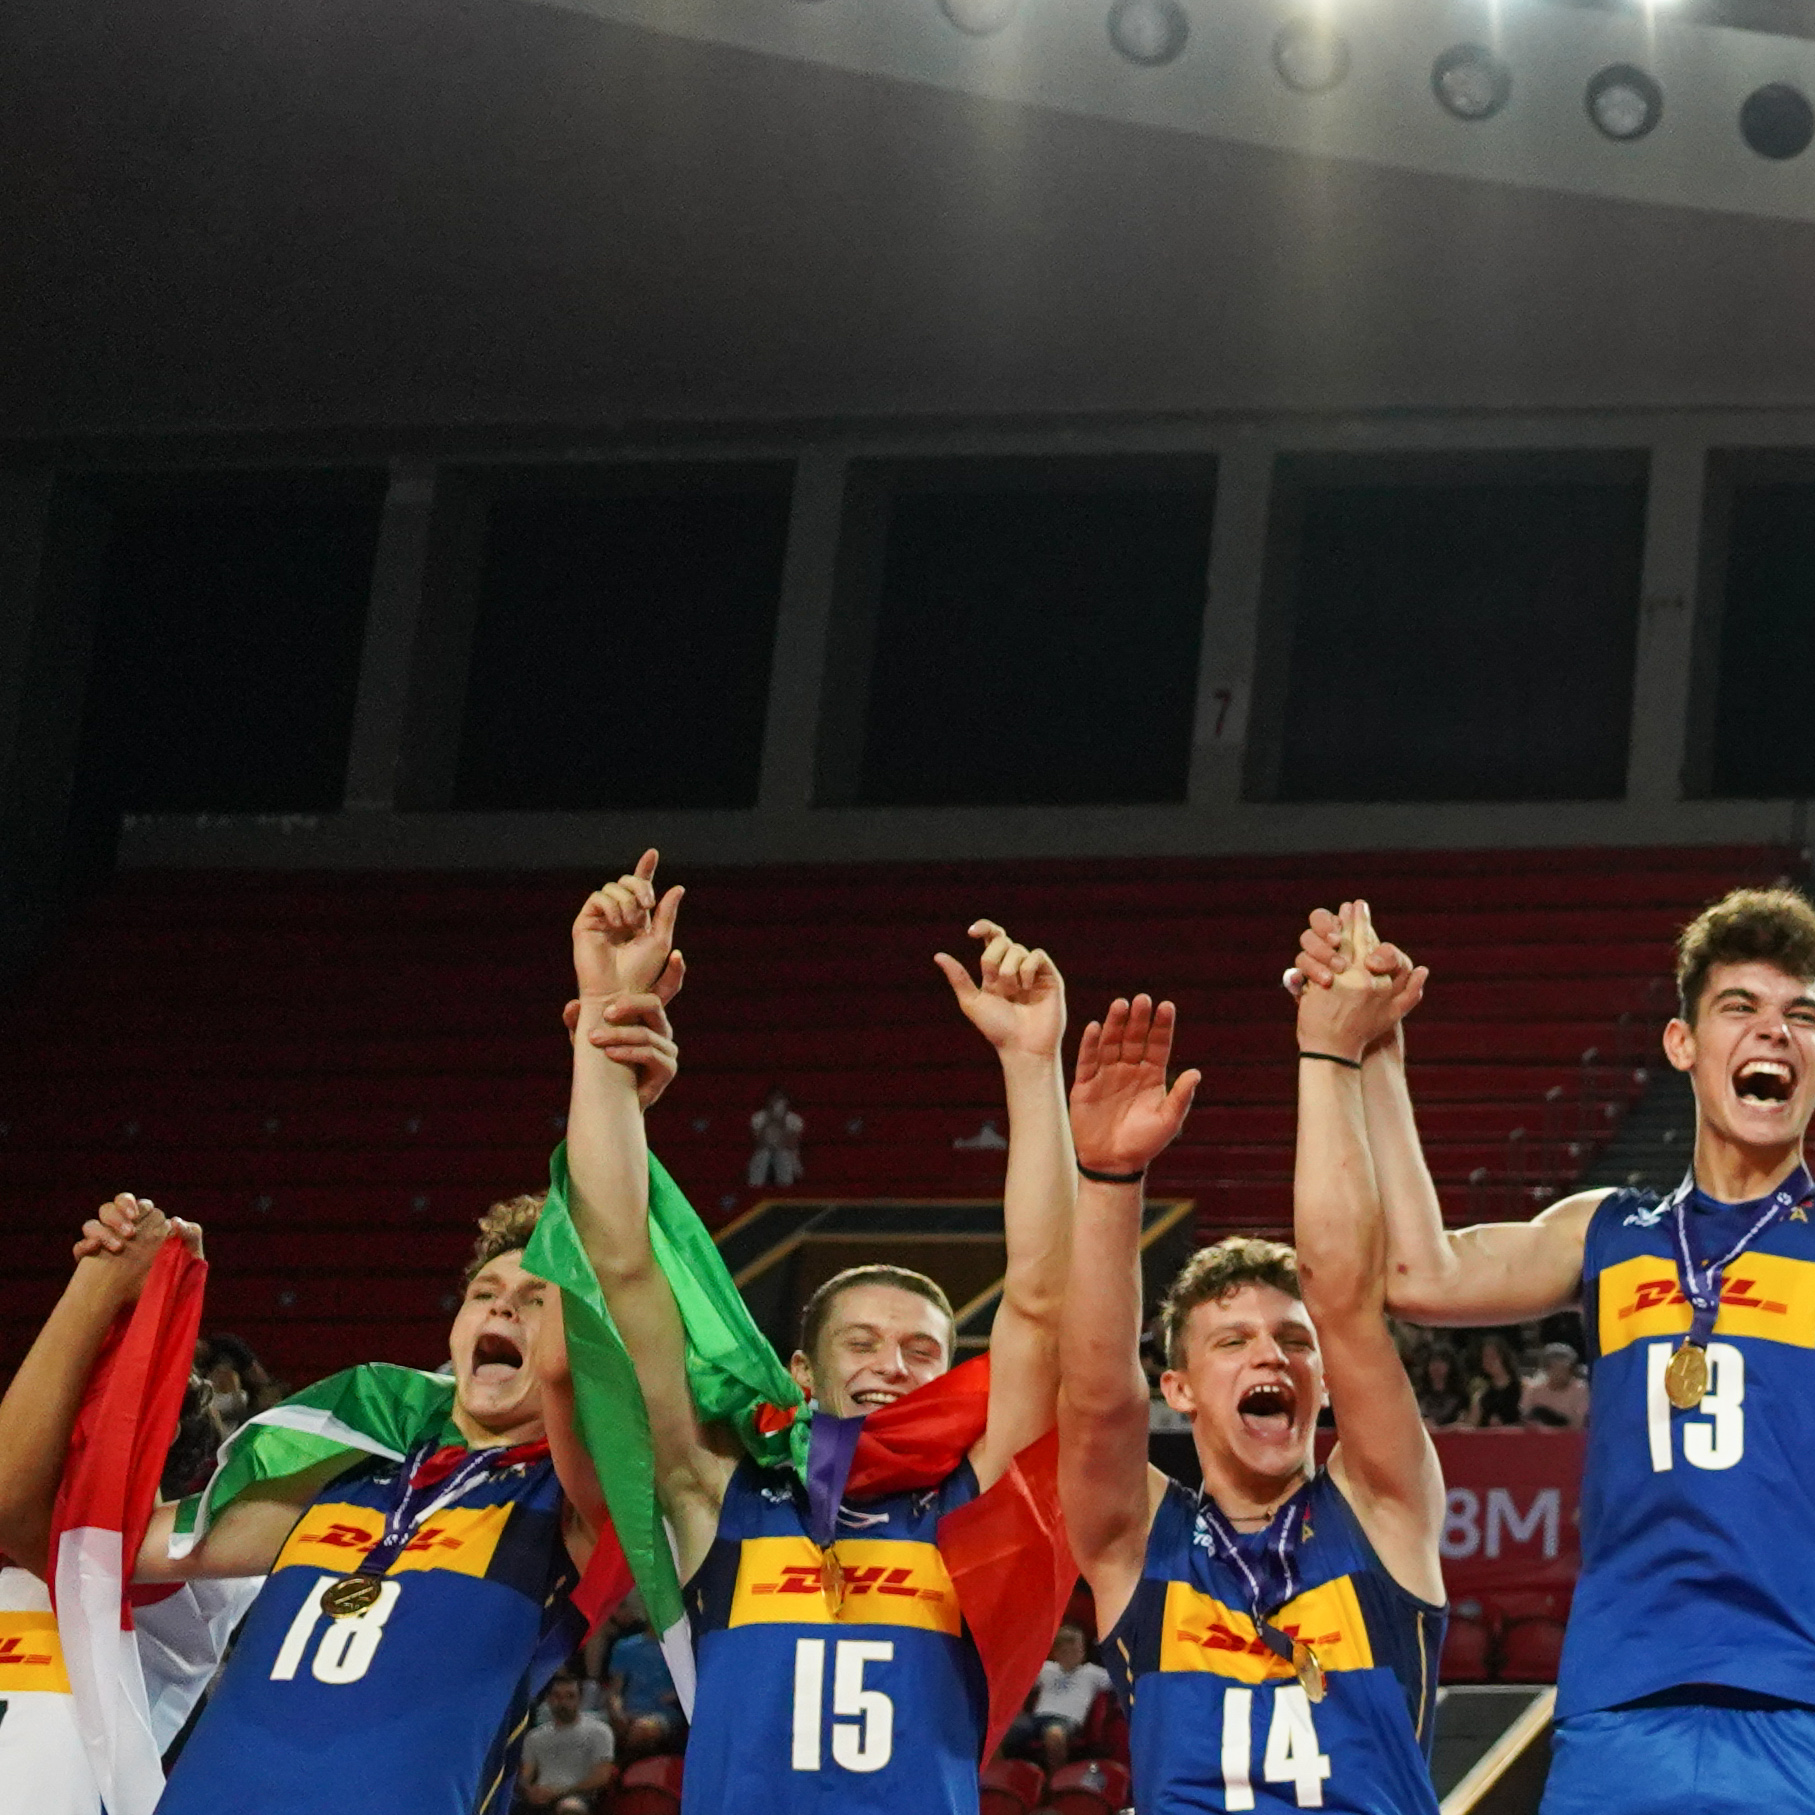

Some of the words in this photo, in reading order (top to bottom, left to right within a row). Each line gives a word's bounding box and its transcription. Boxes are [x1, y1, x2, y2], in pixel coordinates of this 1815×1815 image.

[1647, 1342, 1744, 1473] 13
[269, 1575, 401, 1685] 18
[791, 1638, 894, 1773] 15
[1220, 1685, 1332, 1812] 14
